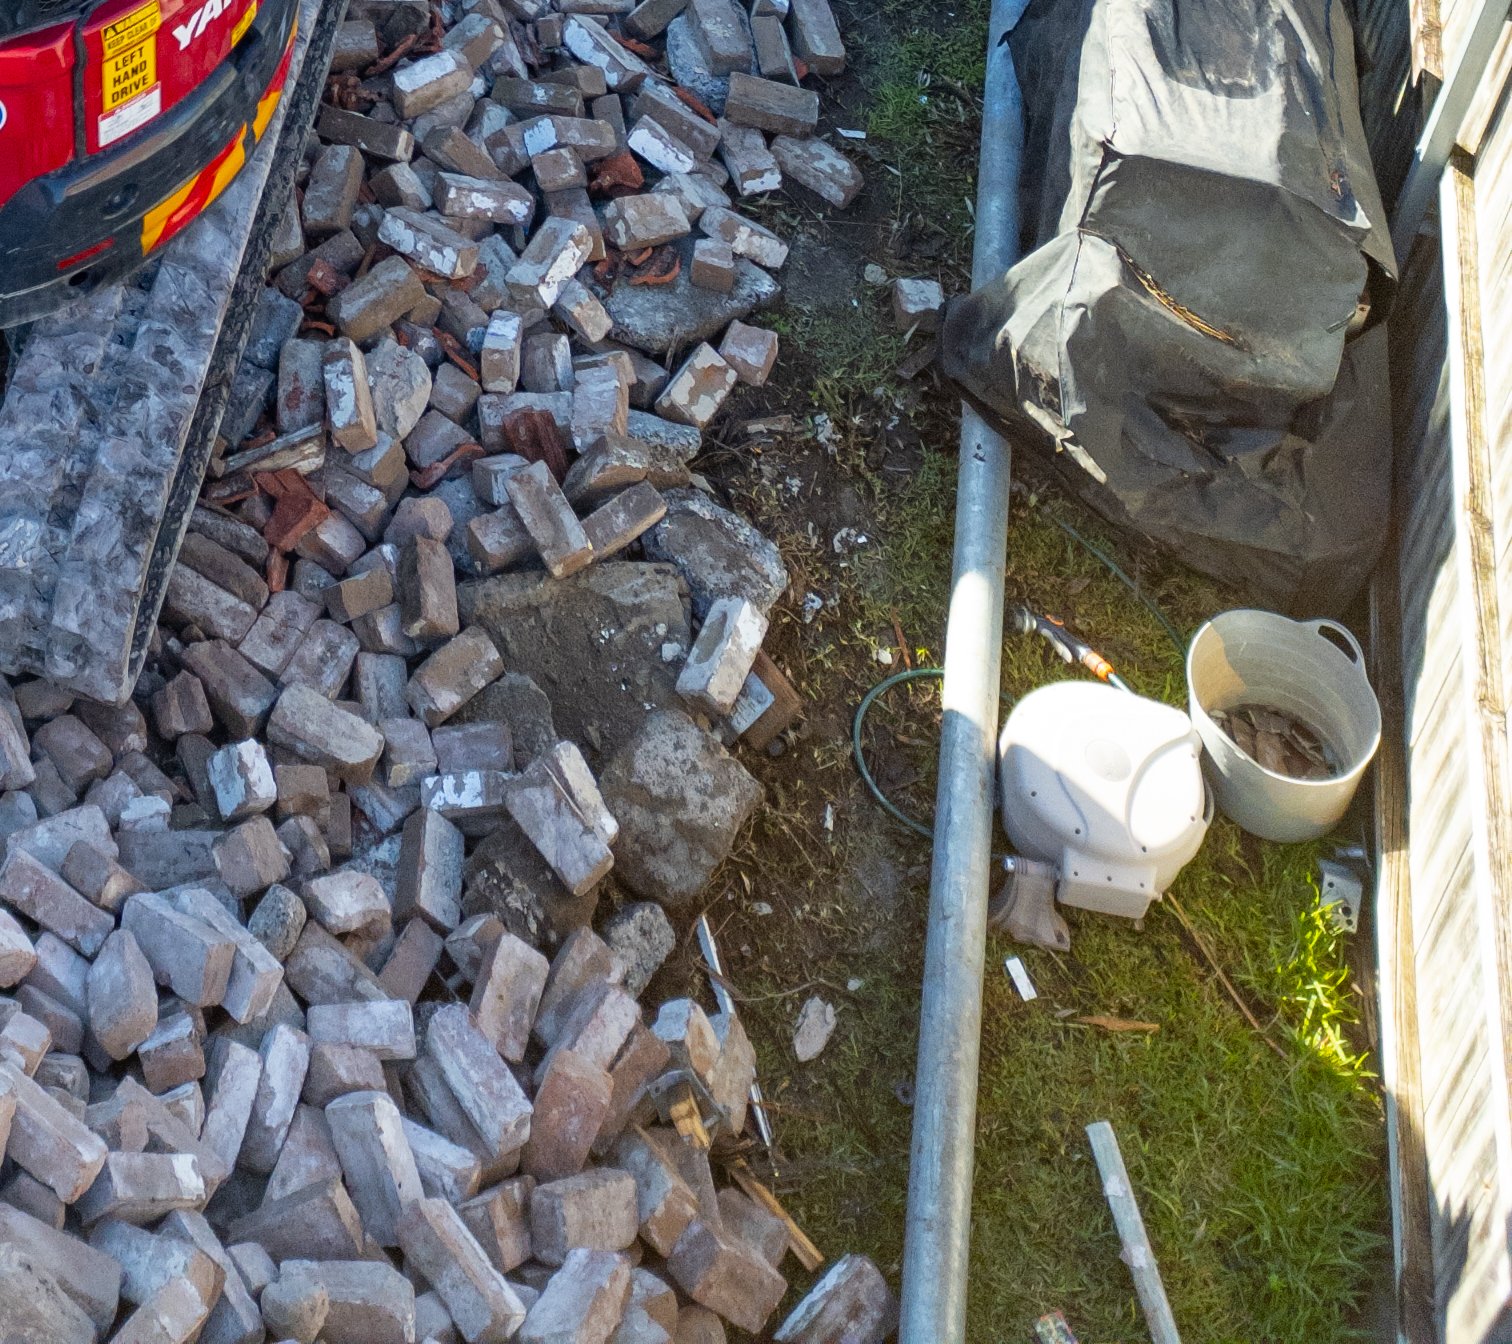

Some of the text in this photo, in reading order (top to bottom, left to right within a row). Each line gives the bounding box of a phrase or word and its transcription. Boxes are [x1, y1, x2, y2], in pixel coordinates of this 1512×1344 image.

[114, 46, 145, 72] LEFT
[112, 60, 147, 88] HAND
[111, 73, 149, 104] DRIVE
